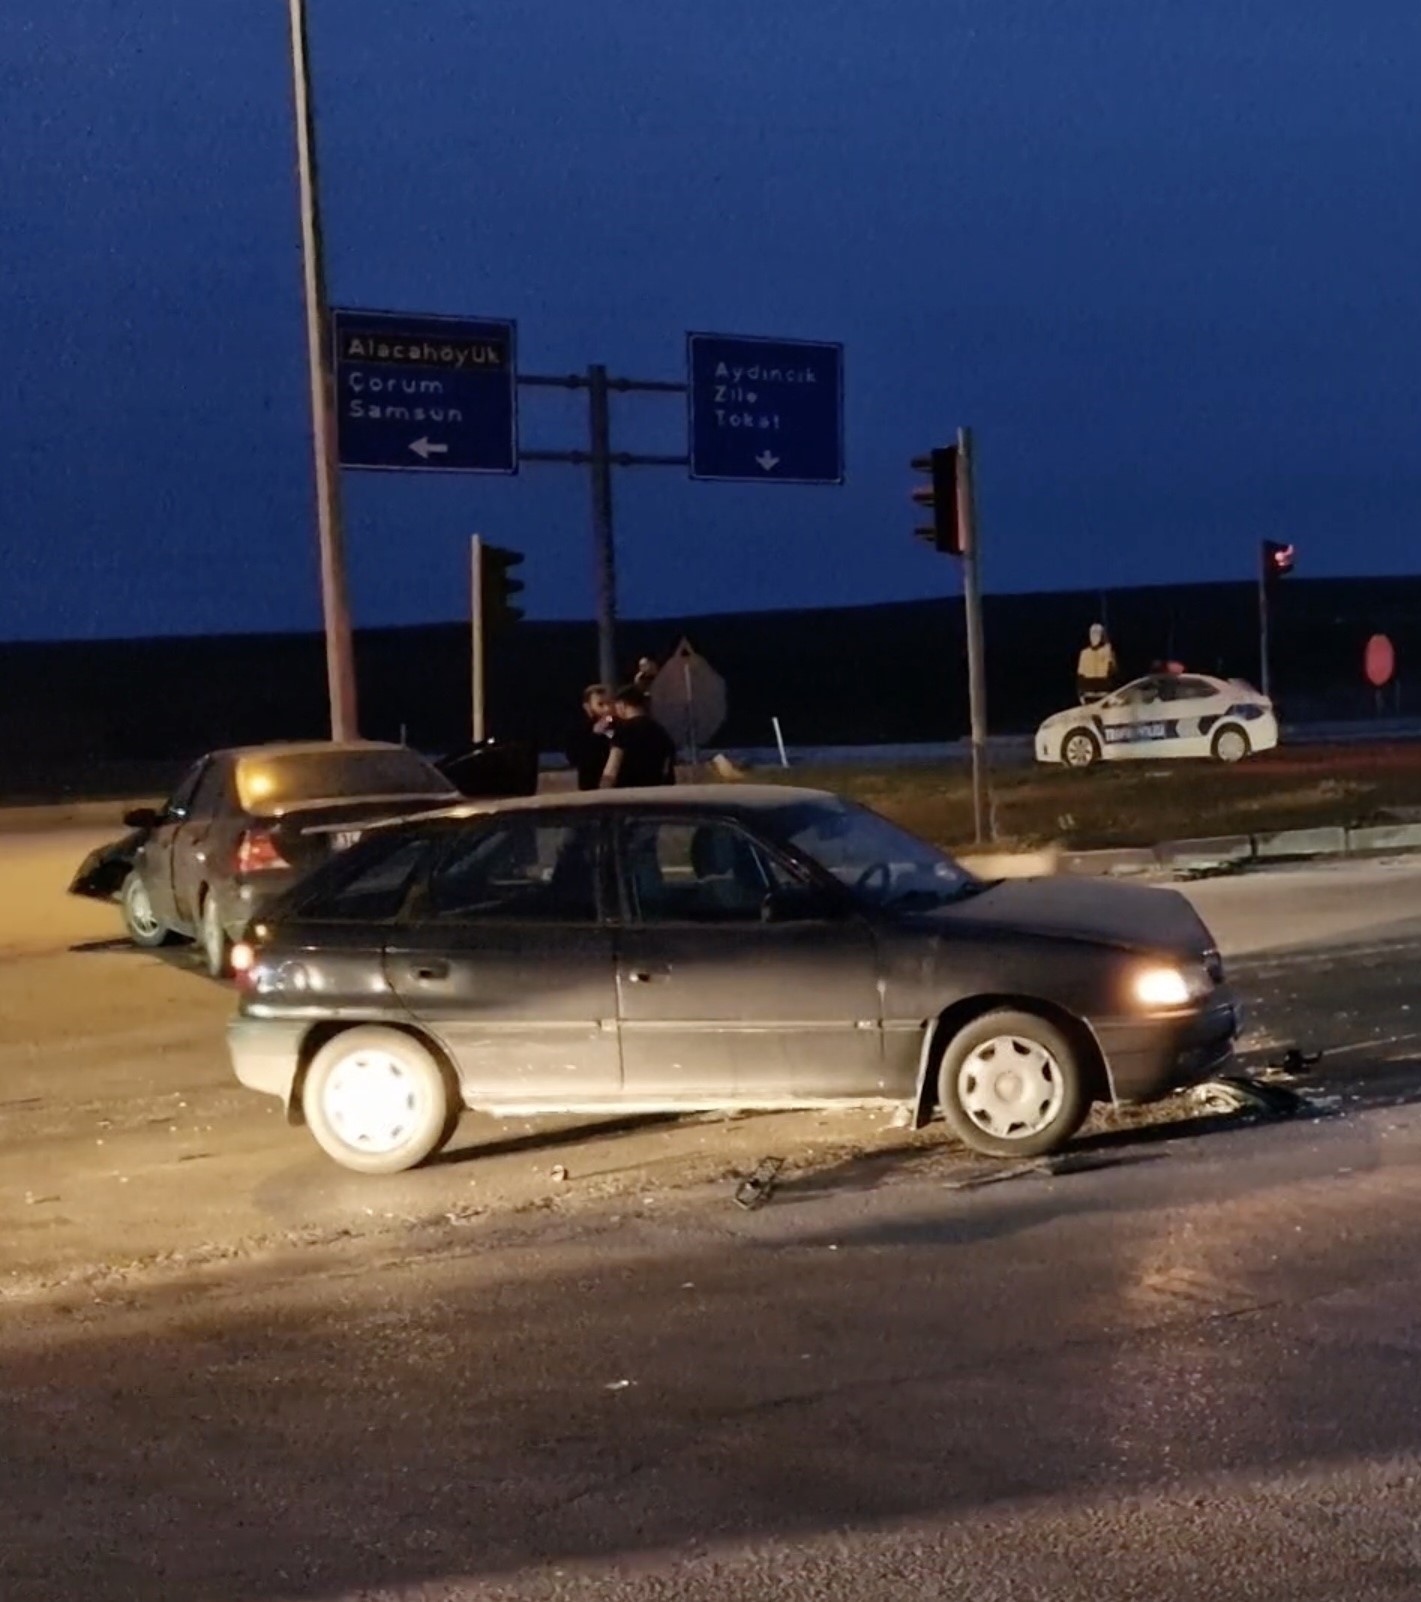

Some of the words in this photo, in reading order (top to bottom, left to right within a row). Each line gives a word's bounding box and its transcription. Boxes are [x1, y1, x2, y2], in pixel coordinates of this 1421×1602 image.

[349, 371, 443, 394] Çorum
[349, 399, 462, 422] Samsun
[714, 409, 780, 430] Tokat
